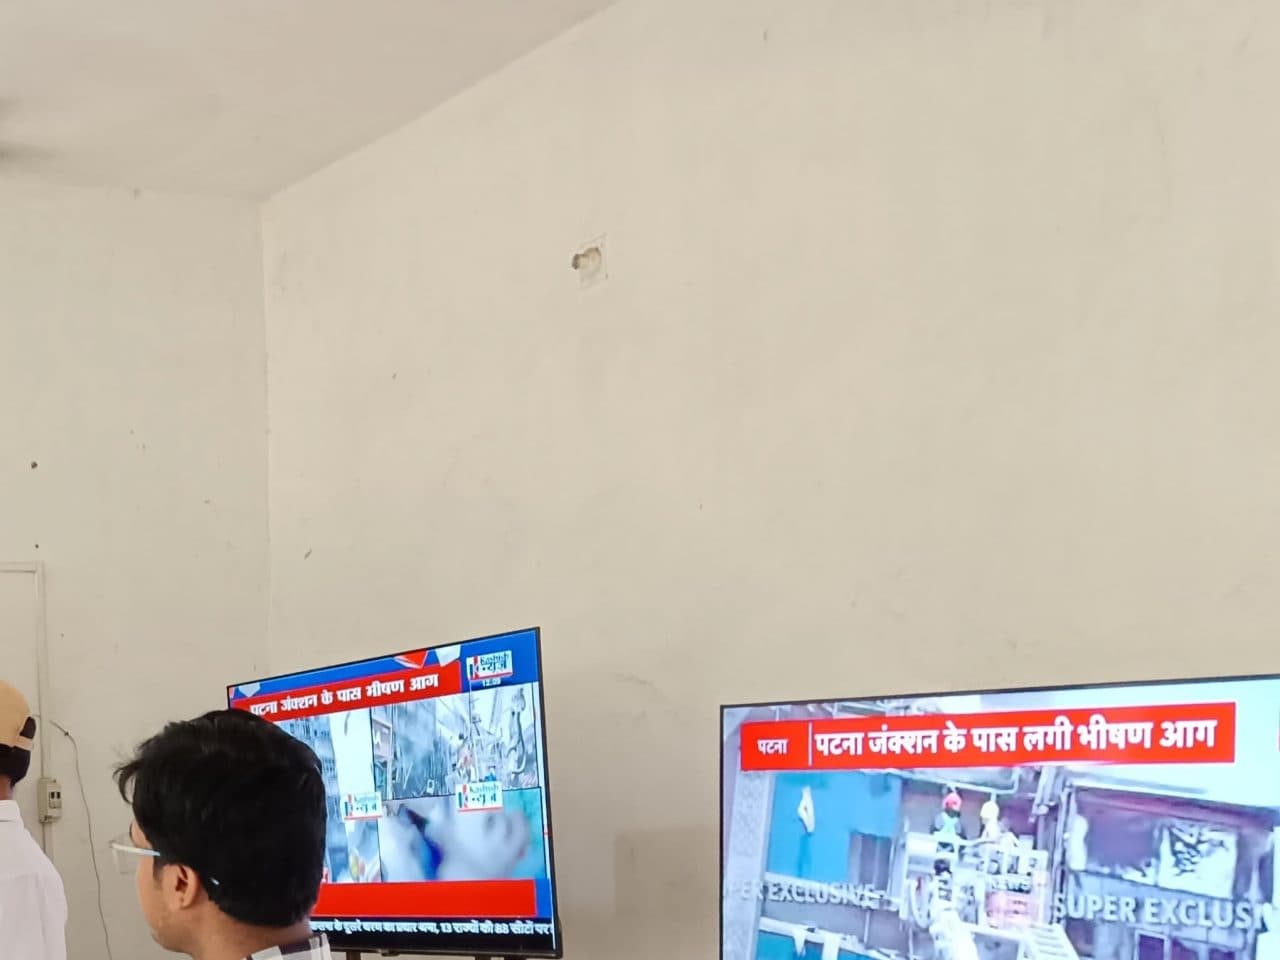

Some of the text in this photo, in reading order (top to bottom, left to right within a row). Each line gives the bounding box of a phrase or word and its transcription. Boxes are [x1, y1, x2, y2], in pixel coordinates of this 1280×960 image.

[250, 701, 278, 715] पटना
[280, 695, 318, 711] जंक्शन
[321, 688, 334, 705] के
[337, 687, 361, 703] पास
[408, 673, 439, 692] आग
[757, 738, 788, 755] पटना
[814, 713, 1218, 756] पटना जंक्शन के पास लगी भीषण आग
[1052, 892, 1137, 924] SUPER
